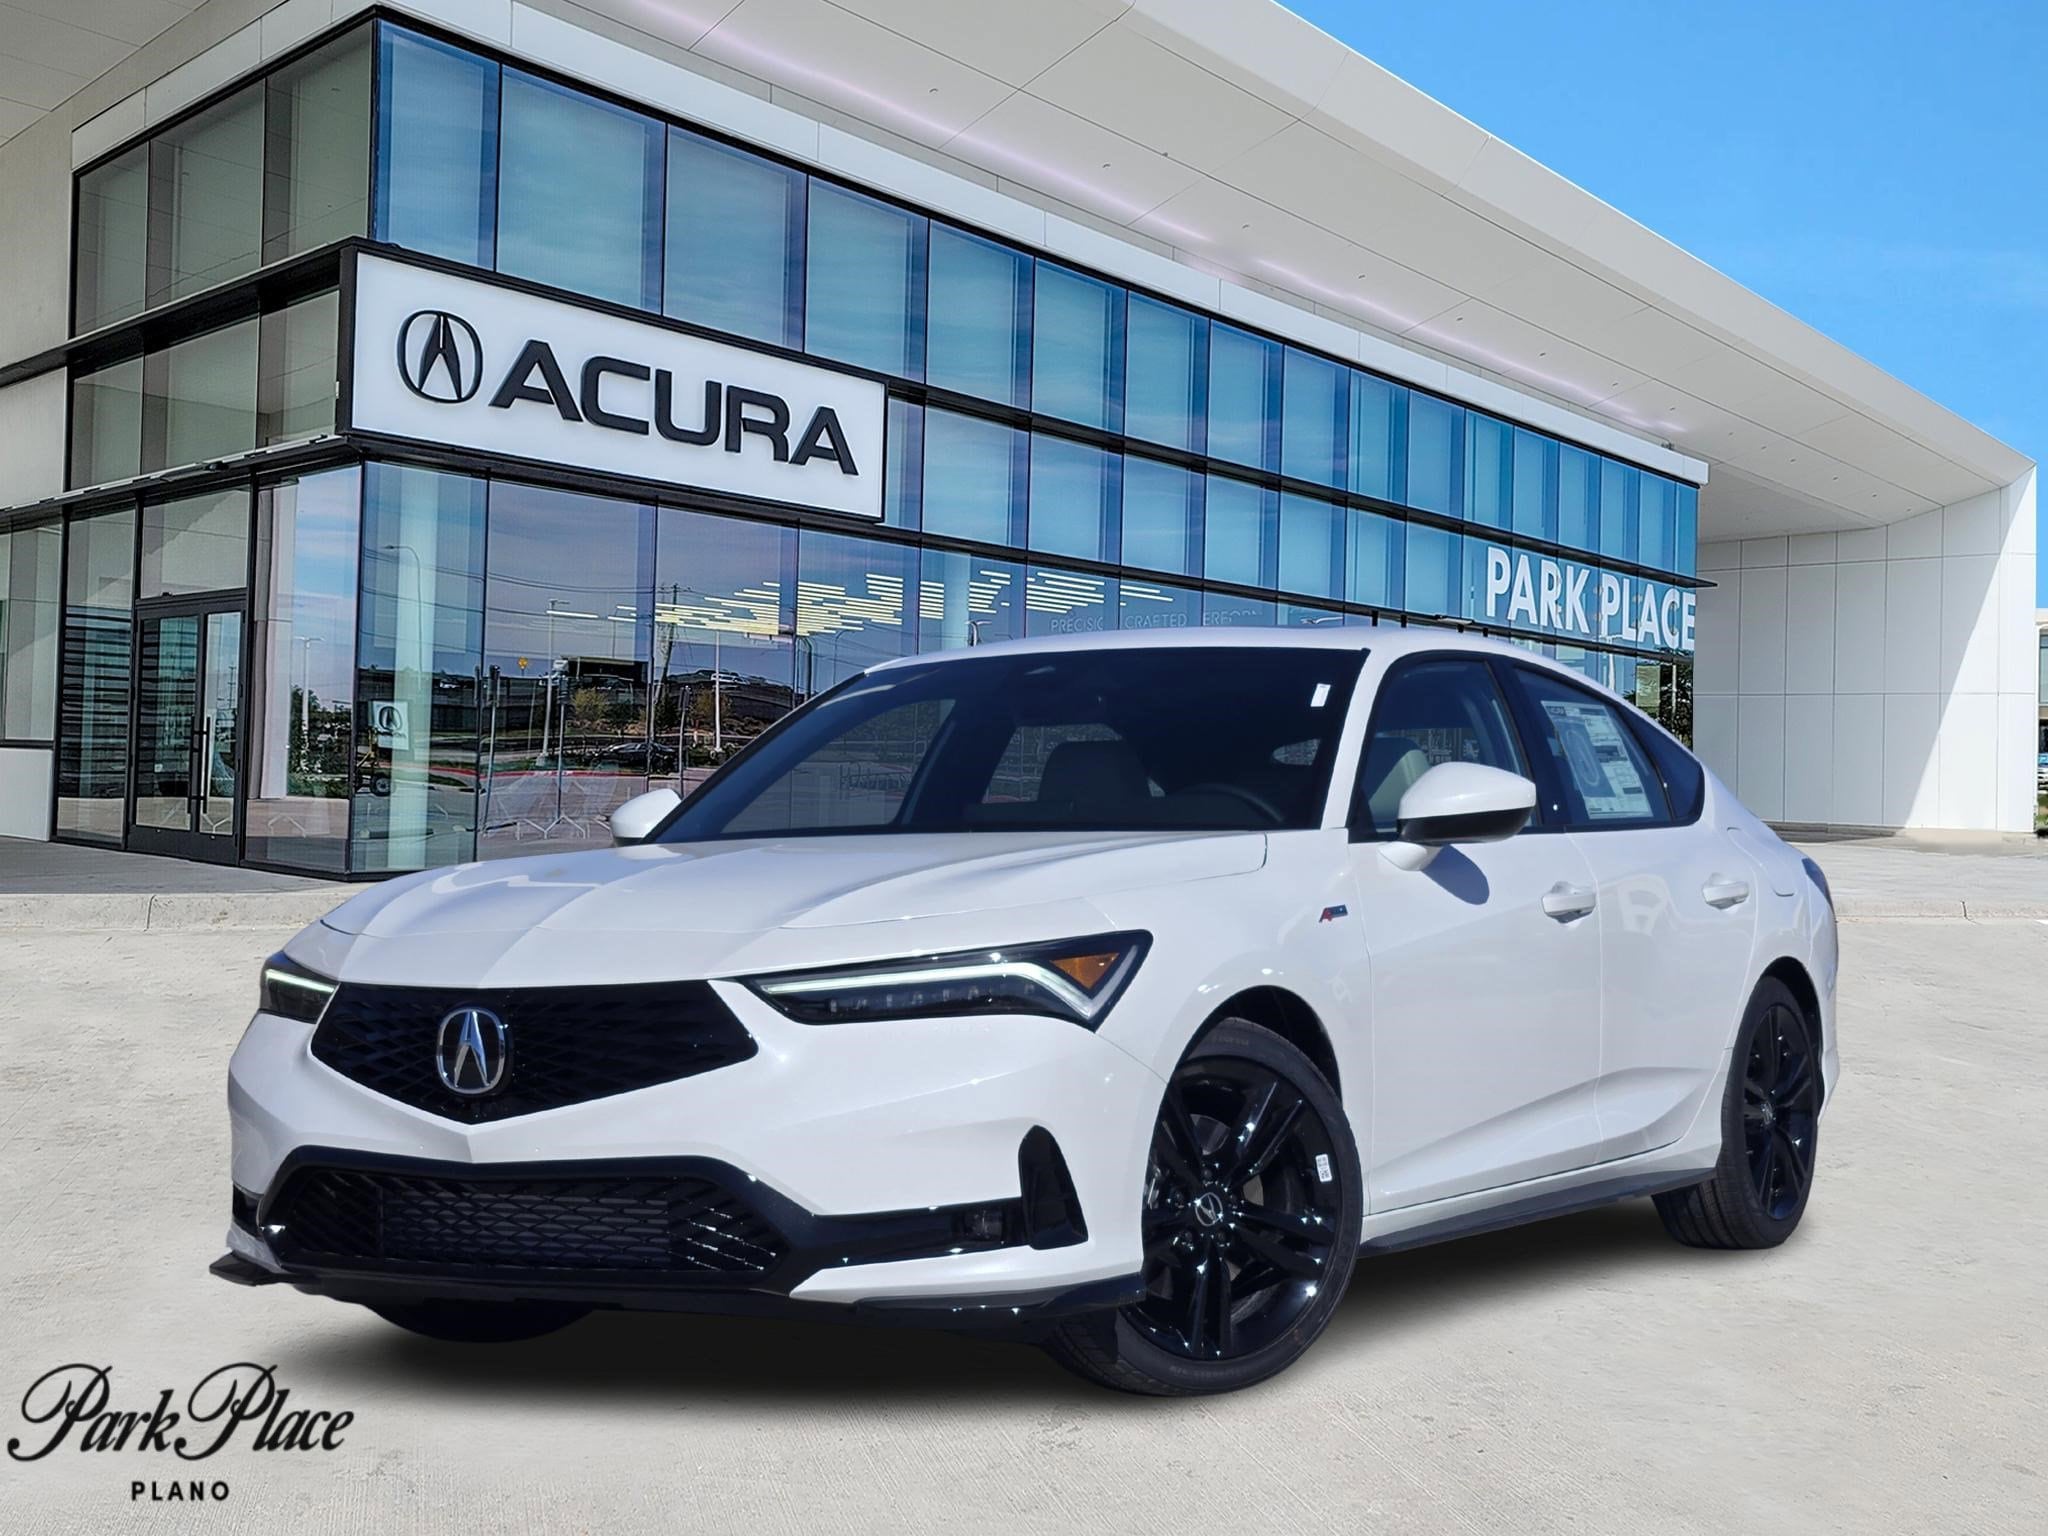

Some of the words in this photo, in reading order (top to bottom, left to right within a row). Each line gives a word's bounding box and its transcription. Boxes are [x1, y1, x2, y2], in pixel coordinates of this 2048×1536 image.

[489, 339, 859, 475] ACURA
[1125, 613, 1187, 629] CRAFTED
[1487, 546, 1590, 633] PARK
[1601, 573, 1695, 650] PLACE
